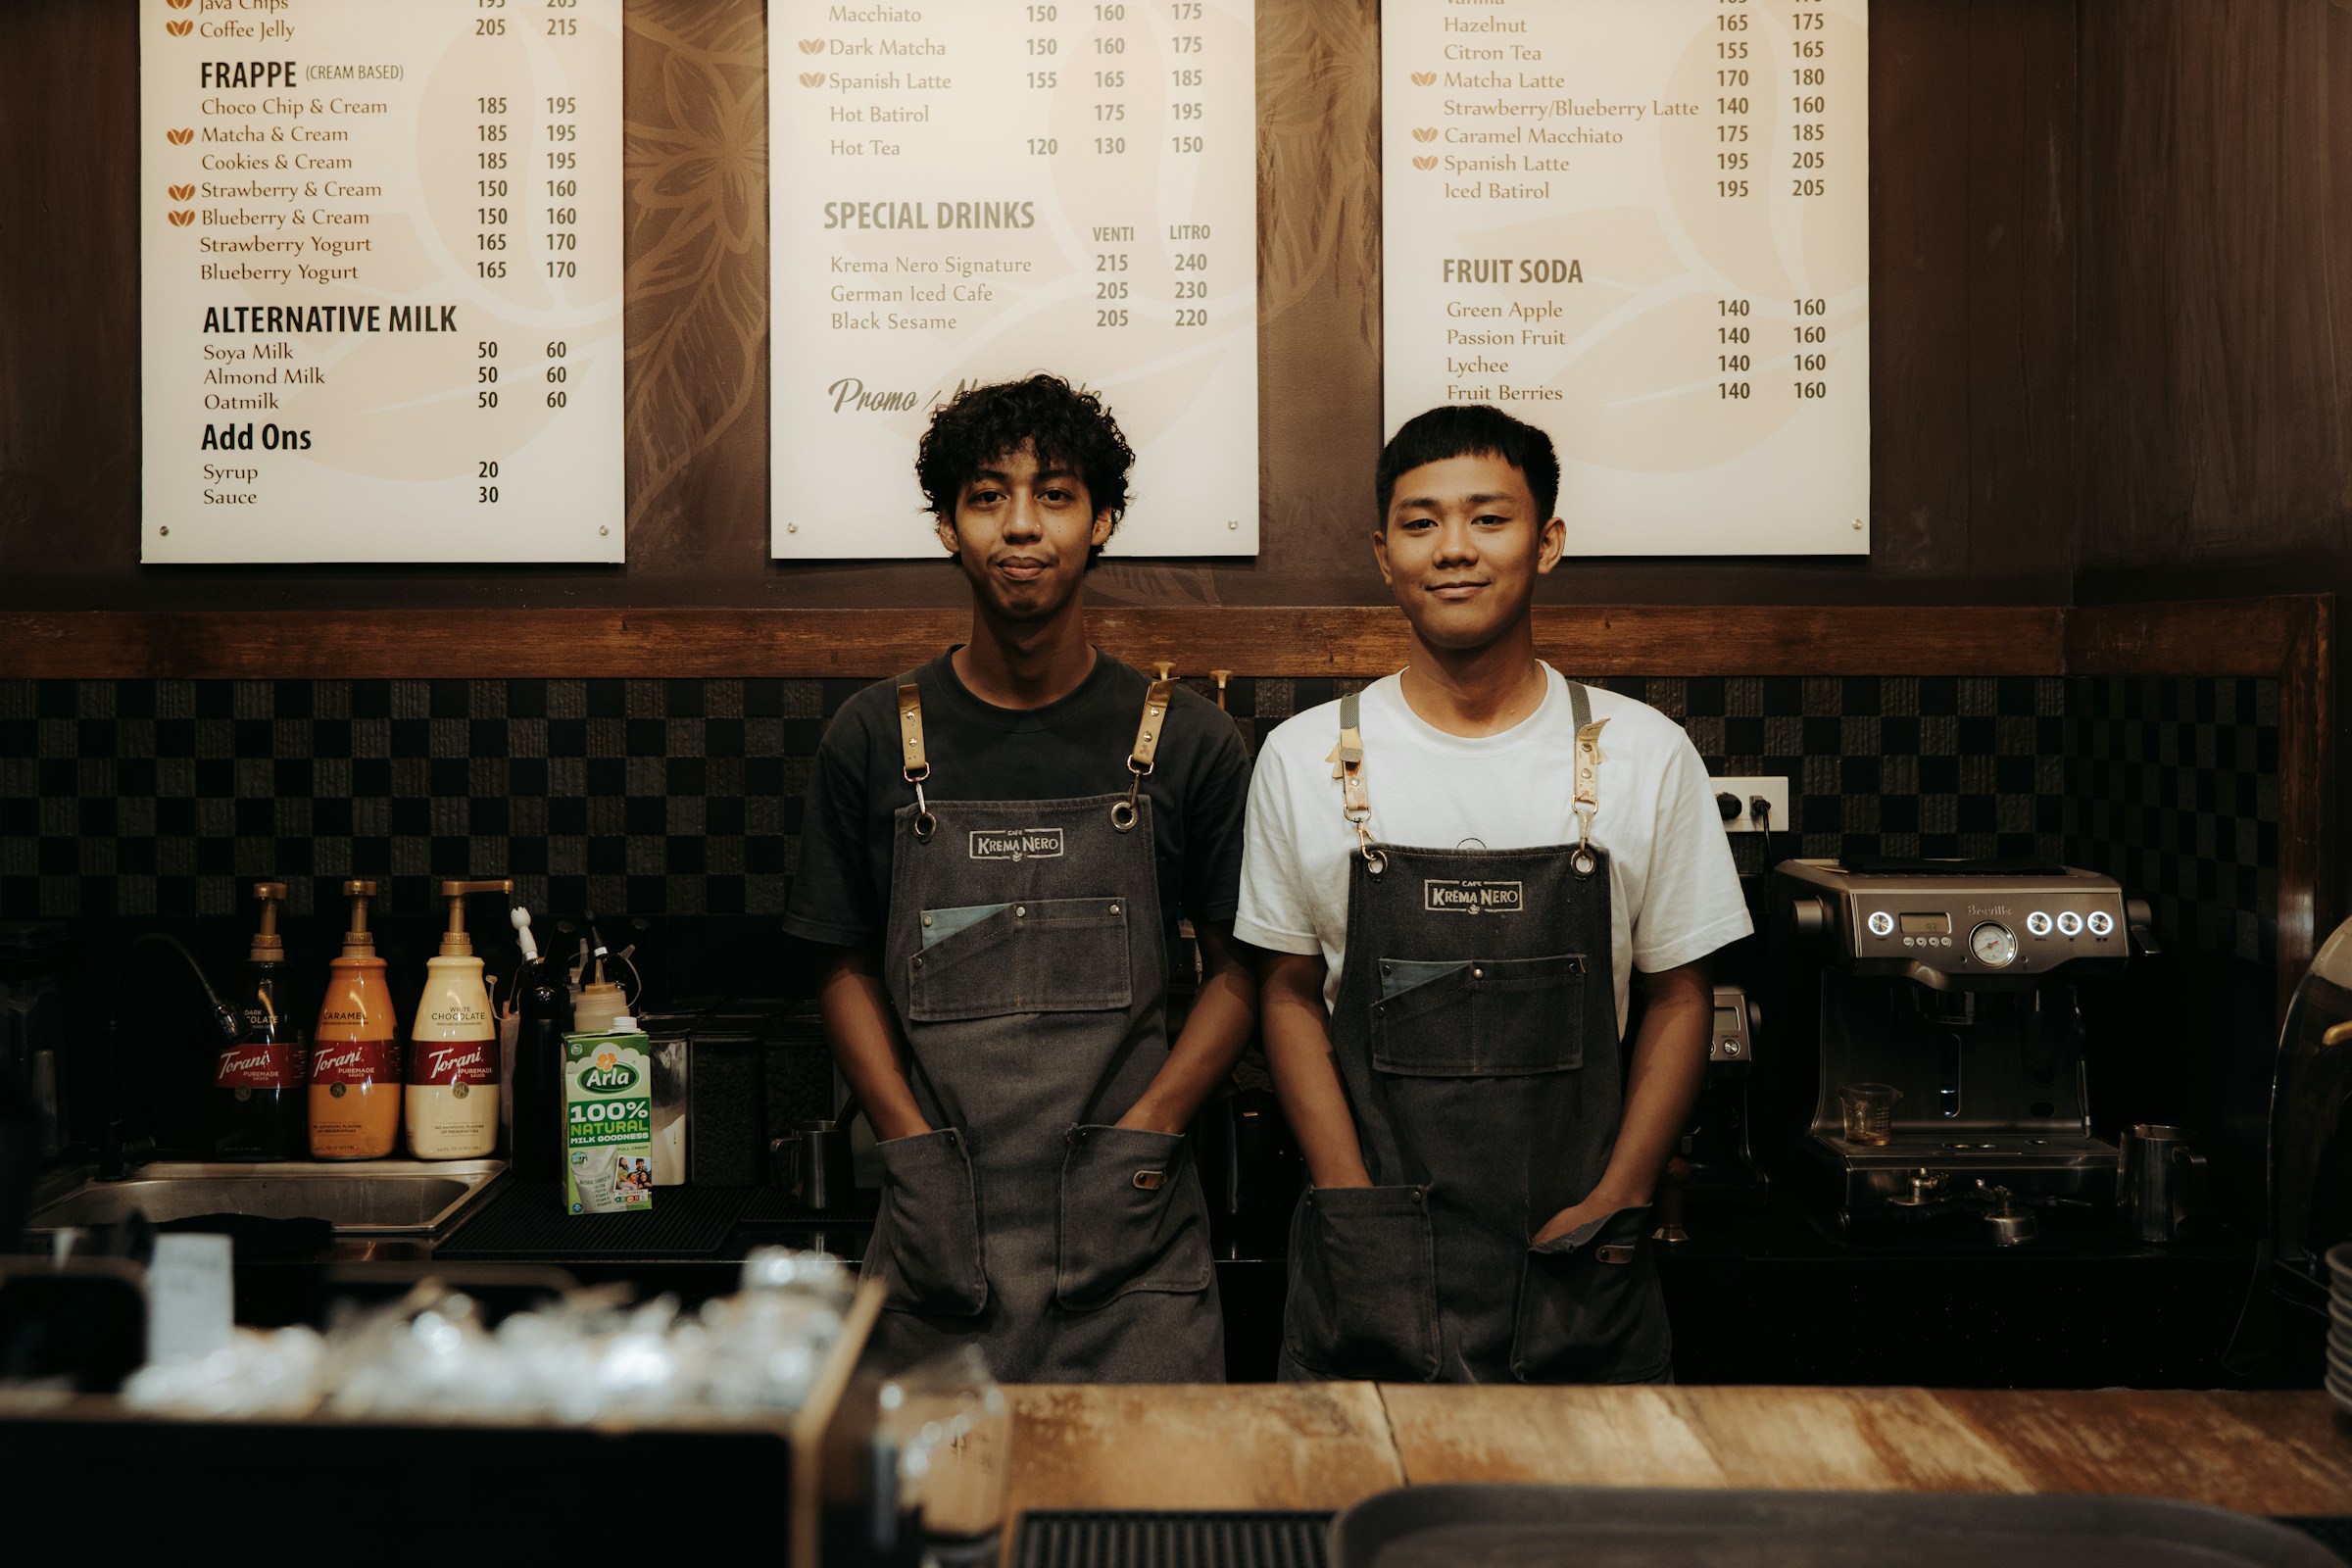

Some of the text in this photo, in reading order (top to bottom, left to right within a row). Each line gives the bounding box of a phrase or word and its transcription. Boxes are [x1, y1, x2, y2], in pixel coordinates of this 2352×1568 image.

[829, 4, 922, 23] Macchiato
[1444, 12, 1825, 33] Hazelnut 165 175
[200, 18, 577, 43] Coffee Jelly 205 215
[829, 37, 946, 56] Dark Matcha
[1444, 40, 1825, 61] Citron Tea 155 165
[200, 61, 404, 89] FRAPPE (CREAM BASED)
[829, 71, 952, 94] Spanish Latte
[1444, 68, 1826, 89] Matcha Latte 170 180
[201, 96, 576, 120] Choco Chip Cream 185 195
[830, 104, 929, 122] Hot Batirol
[1444, 95, 1826, 122] Strawberry/Blueberry Latte 140 160
[201, 123, 576, 143] Matcha Cream 185 195
[1445, 123, 1825, 144] Caramel Macchiato 175 185
[830, 139, 901, 156] Hot Tea
[201, 152, 576, 171] Cookies Cream 185 195
[1444, 151, 1825, 176] Spanish Latte 195 205
[201, 179, 577, 203] Strawberry Cream 150 160
[1445, 178, 1825, 199] Iced Batirol 195 205
[201, 207, 577, 230] Blueberry Cream 150 160
[823, 201, 1036, 229] SPECIAL DRINKS
[1092, 223, 1211, 242] VENTI LITRO
[200, 232, 577, 258] Strawberry Yogurt 165 170
[200, 261, 577, 285] Blueberry Yogurt 165 170
[830, 253, 1207, 278] Krema Nero Signature 215 240
[1443, 258, 1584, 284] FRUIT SODA
[830, 280, 1208, 302] German Iced Cafe 205 230
[202, 305, 458, 334] ALTERNATIVE MILK
[830, 308, 1208, 330] Black Sesame 205 220
[1446, 298, 1827, 323] Green Apple 140 160
[1446, 325, 1827, 346] Passion Fruit 140 160
[203, 340, 567, 366] Soya Milk 50 60
[203, 366, 567, 385] Almond Milk 50 60
[1446, 353, 1827, 378] Lychee 140 160
[204, 390, 567, 411] Oatmilk 50 60
[828, 377, 919, 414] Promo
[1446, 380, 1827, 402] Fruit Berries 140 160
[200, 422, 313, 452] Add Ons
[203, 461, 499, 485] Syrup 20
[203, 485, 500, 505] Sauce 30
[977, 836, 1059, 855] KREMA NERO
[1432, 887, 1519, 906] KREMA NERO
[1967, 904, 2012, 916] Breville
[219, 1050, 270, 1080] Torani
[314, 1046, 363, 1078] Torani
[429, 1046, 482, 1079] Torani
[586, 1067, 629, 1088] Arla
[570, 1101, 649, 1123] 100%
[570, 1119, 649, 1137] NATURAL
[598, 1132, 649, 1143] GOODNESS
